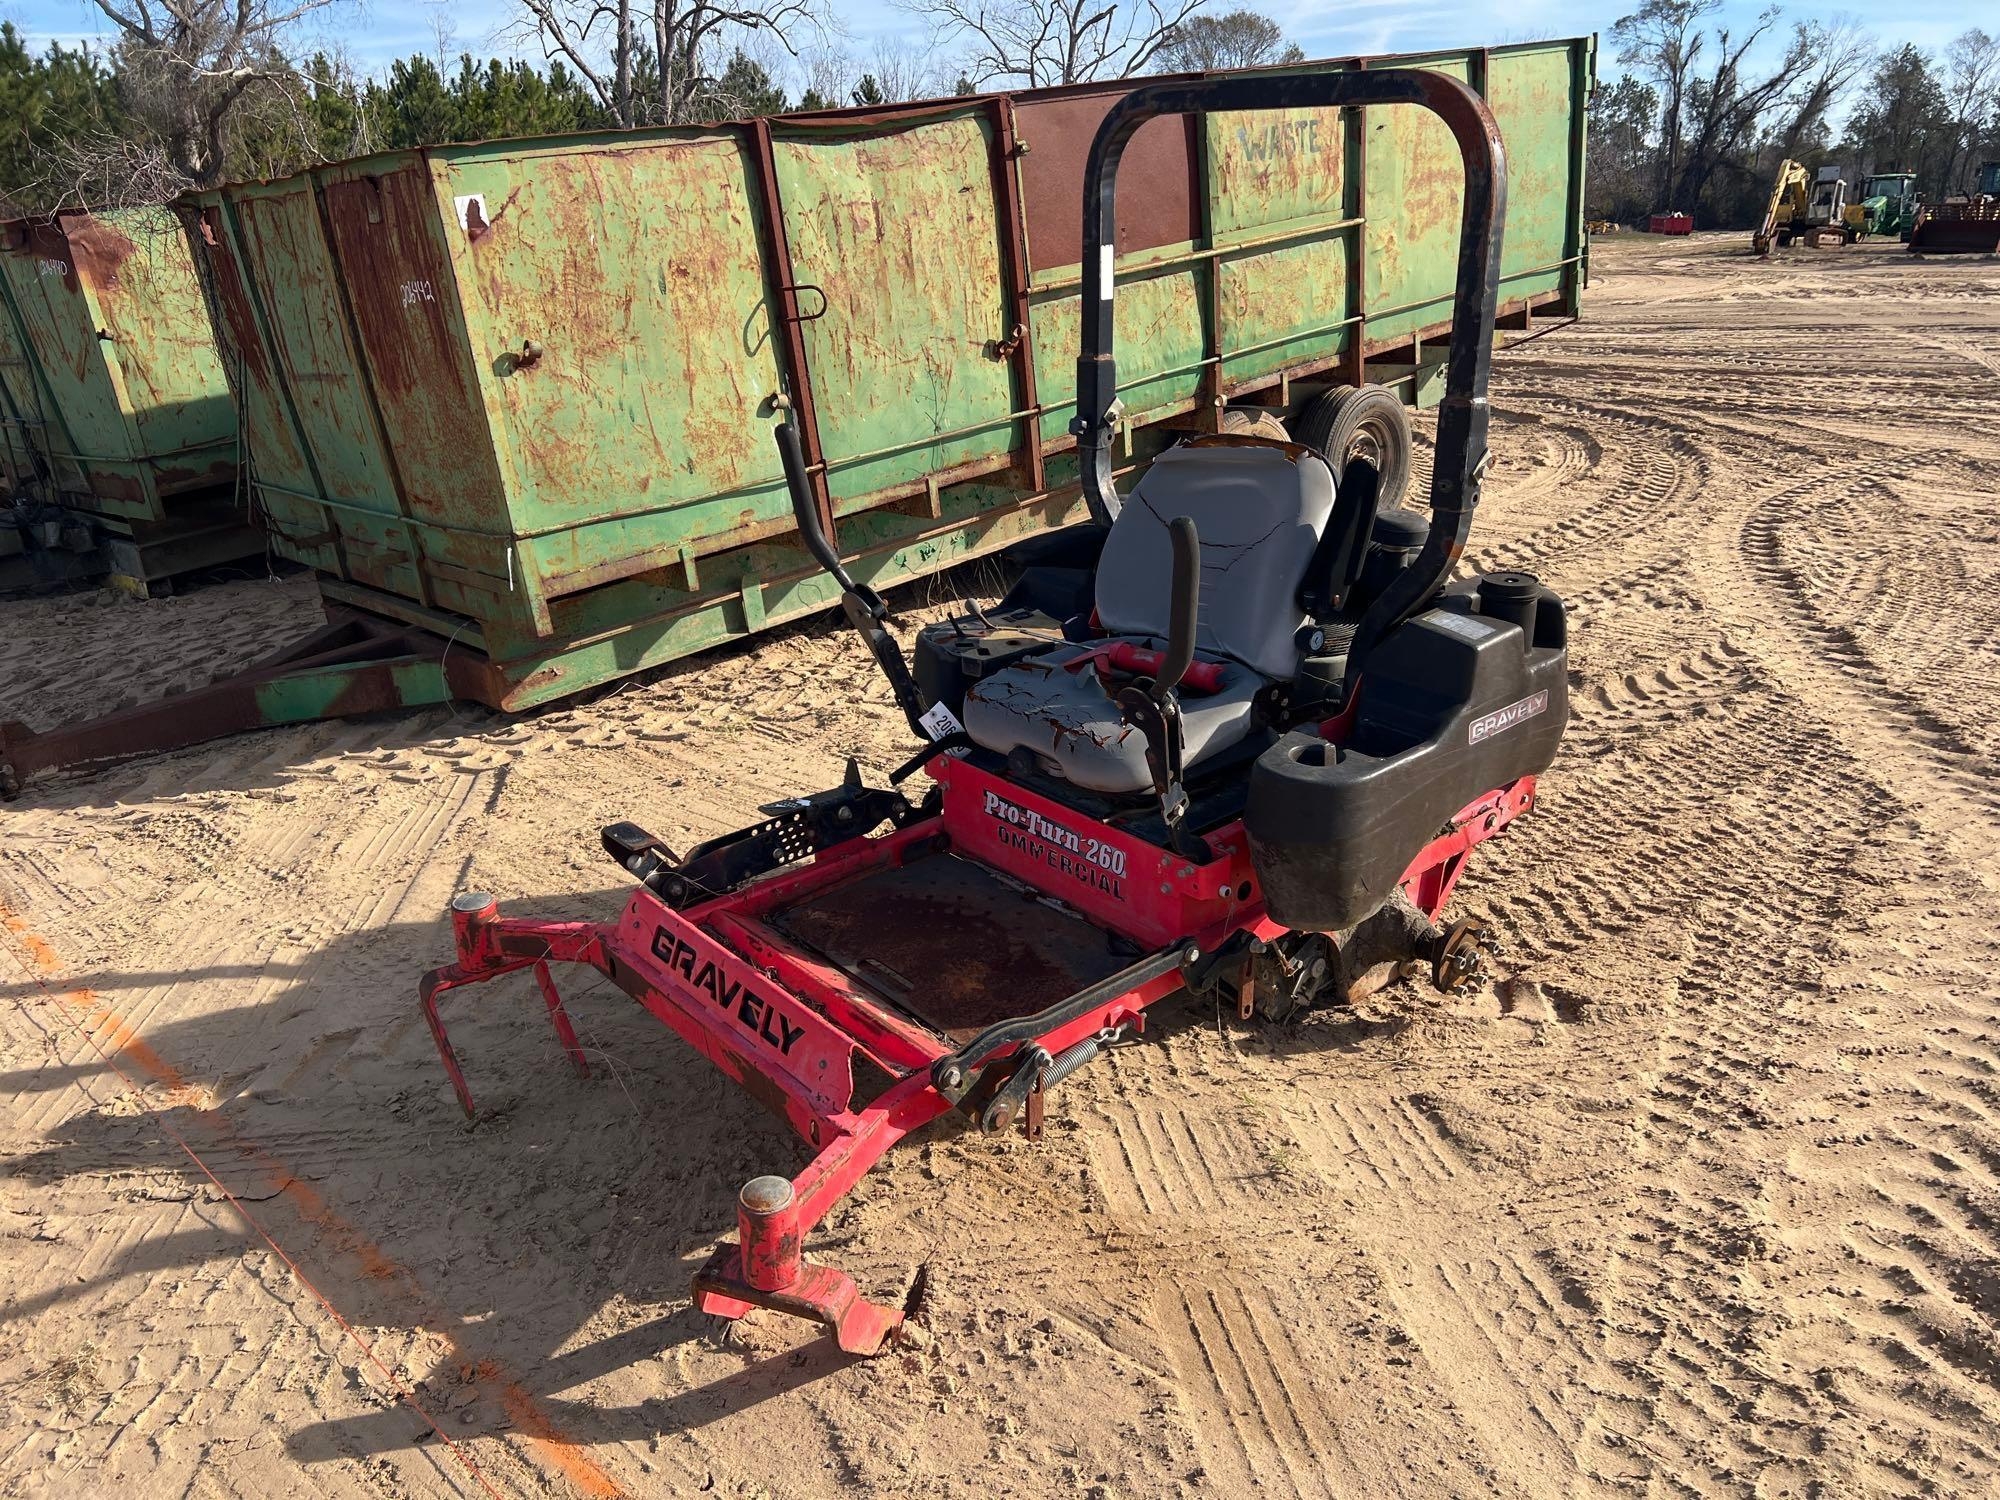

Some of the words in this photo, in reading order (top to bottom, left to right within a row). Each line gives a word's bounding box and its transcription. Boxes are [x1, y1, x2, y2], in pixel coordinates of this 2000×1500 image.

[1237, 120, 1320, 161] WASTE
[1473, 696, 1544, 738] GRAVELY
[985, 791, 1079, 853] Pro-Turn
[1085, 838, 1127, 875] 260
[651, 924, 805, 1056] GRAVELY
